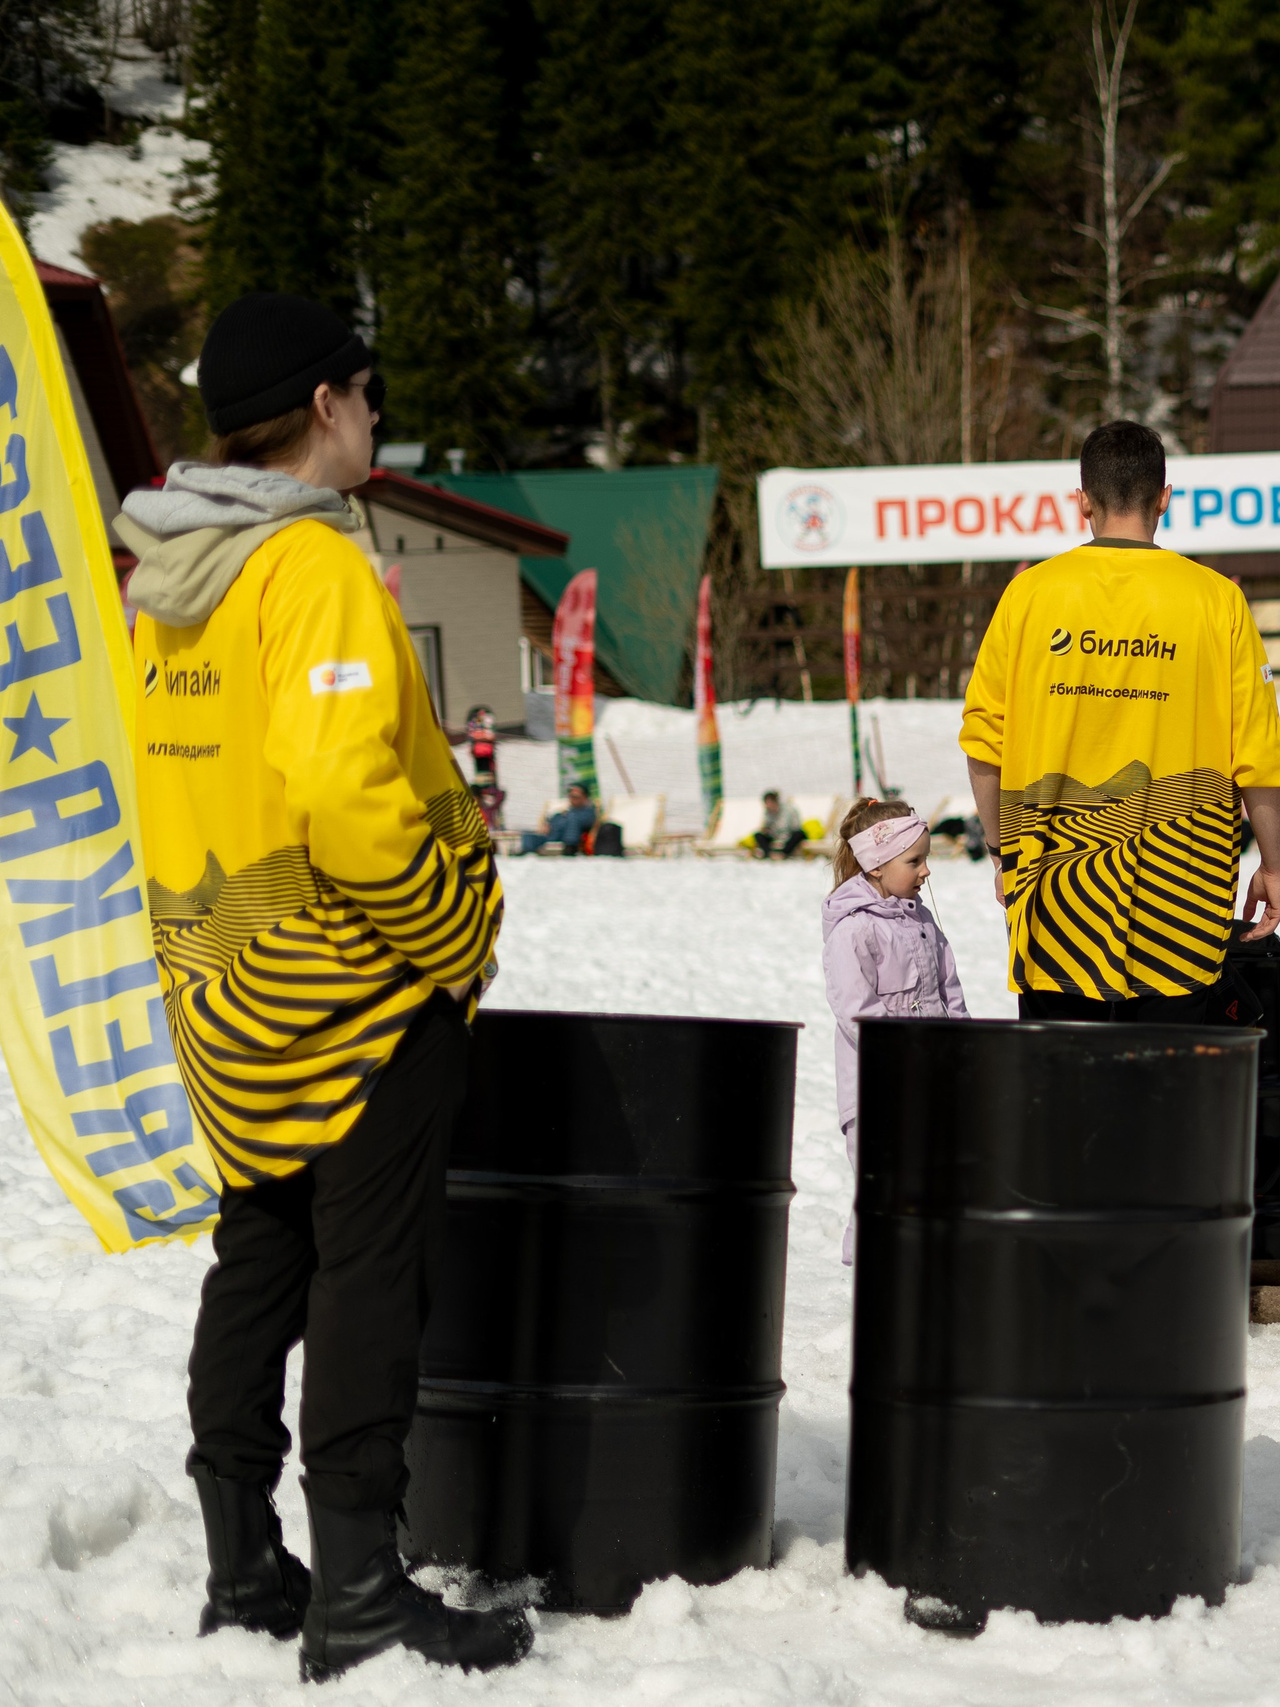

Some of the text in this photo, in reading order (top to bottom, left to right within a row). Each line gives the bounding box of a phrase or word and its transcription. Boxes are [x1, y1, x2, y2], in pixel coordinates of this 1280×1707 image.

[875, 492, 1089, 539] ПРОКАТ
[1080, 629, 1177, 661] билайн
[1049, 682, 1170, 702] #билайнсоединяет
